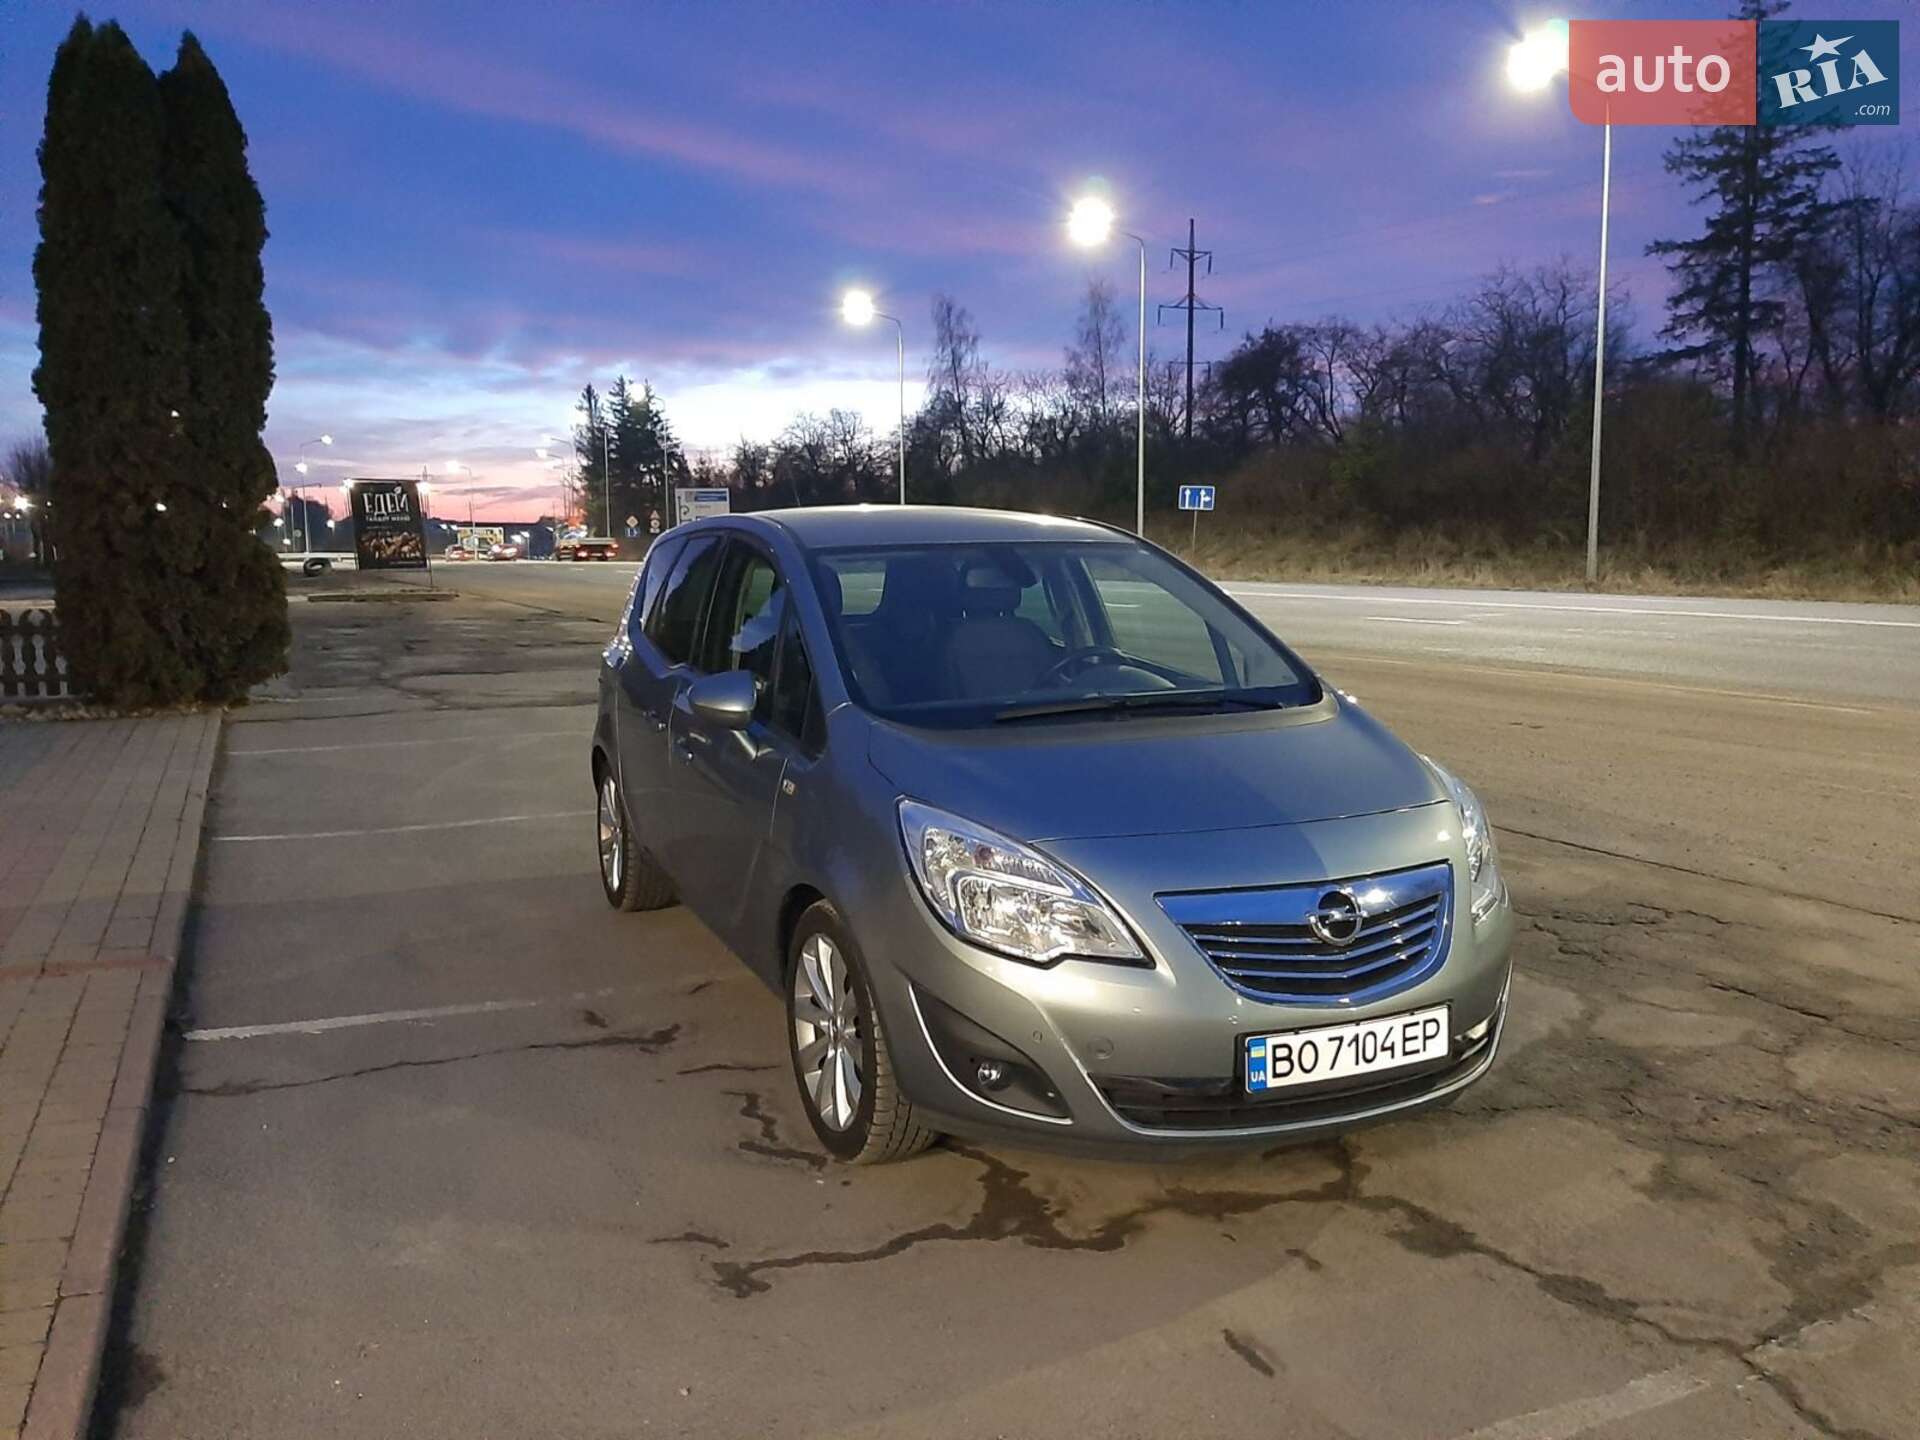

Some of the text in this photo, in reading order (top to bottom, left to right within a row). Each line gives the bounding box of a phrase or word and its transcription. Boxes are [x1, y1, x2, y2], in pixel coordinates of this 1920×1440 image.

[1272, 1018, 1441, 1079] BO 7104 EP
[1251, 1071, 1266, 1082] UA
